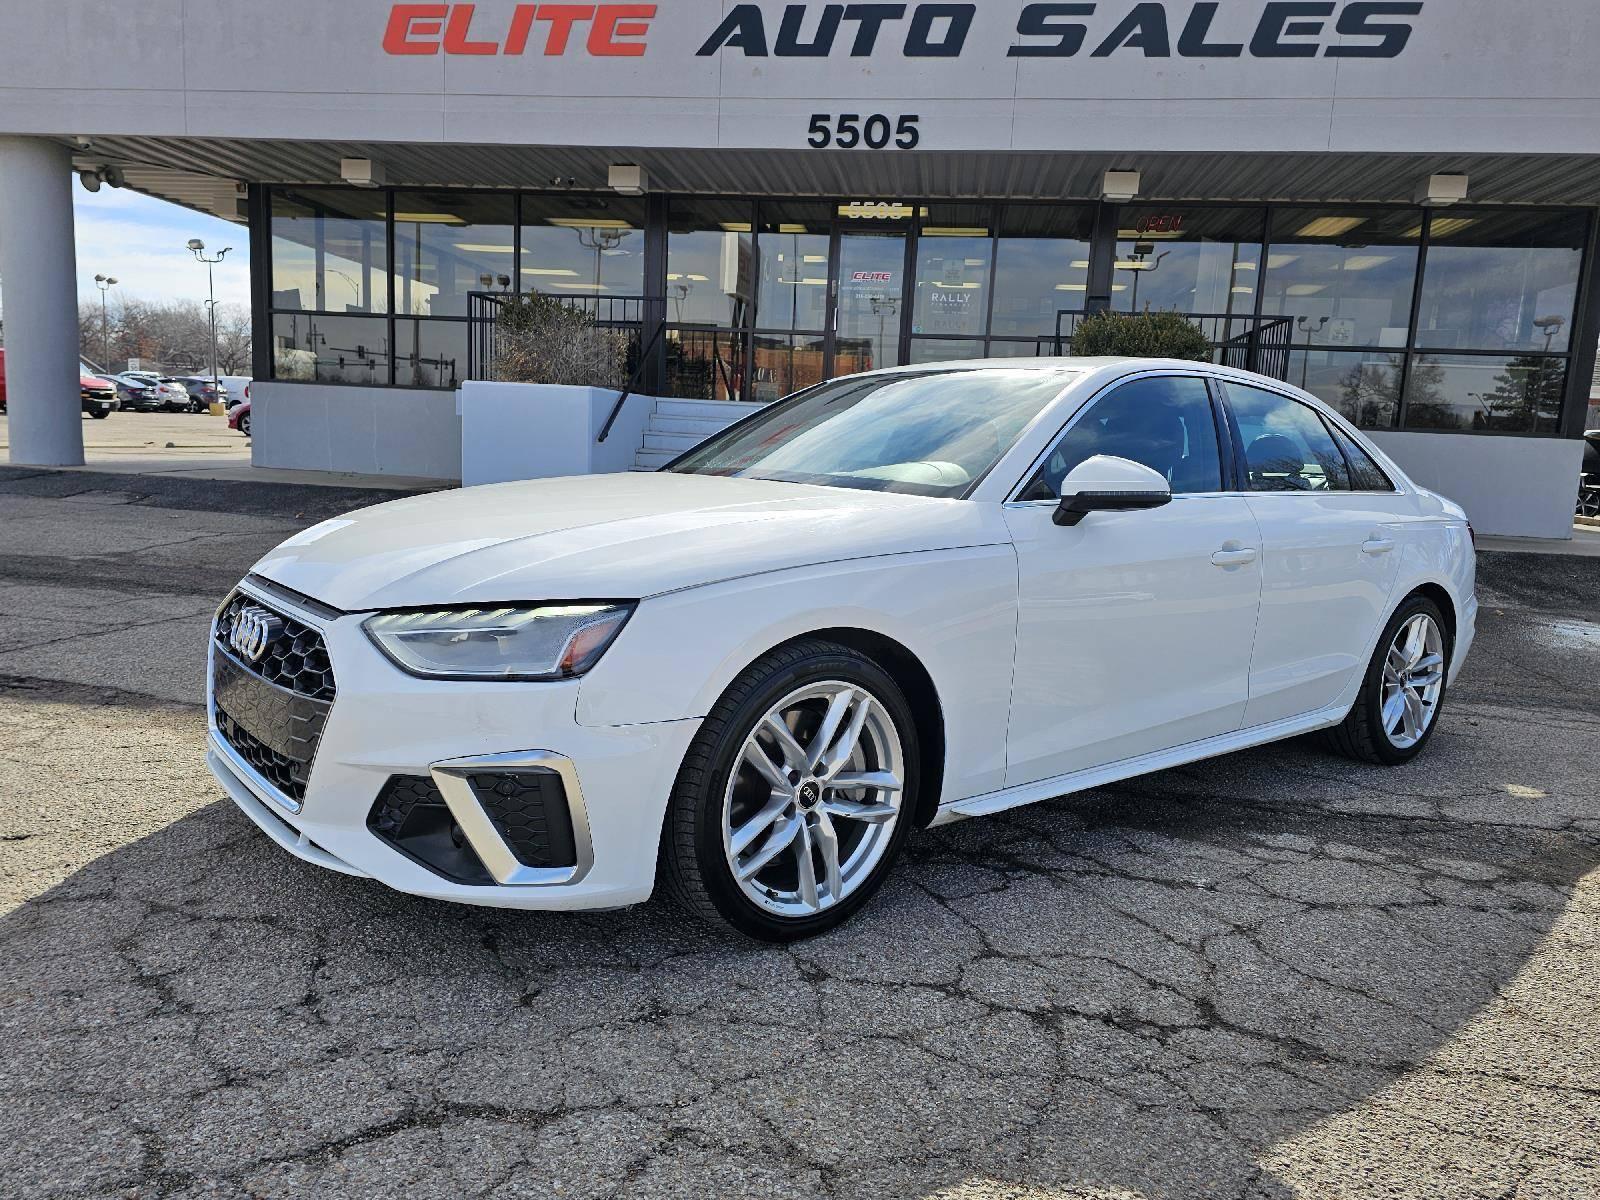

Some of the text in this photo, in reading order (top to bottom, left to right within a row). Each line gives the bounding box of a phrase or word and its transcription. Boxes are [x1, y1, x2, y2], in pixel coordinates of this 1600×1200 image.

[382, 1, 1424, 58] ELITE AUTO SALES
[807, 113, 921, 150] 5505
[848, 201, 904, 219] 5505
[1136, 215, 1183, 233] OPEN
[852, 271, 891, 280] ELITE
[931, 292, 971, 303] RALLY
